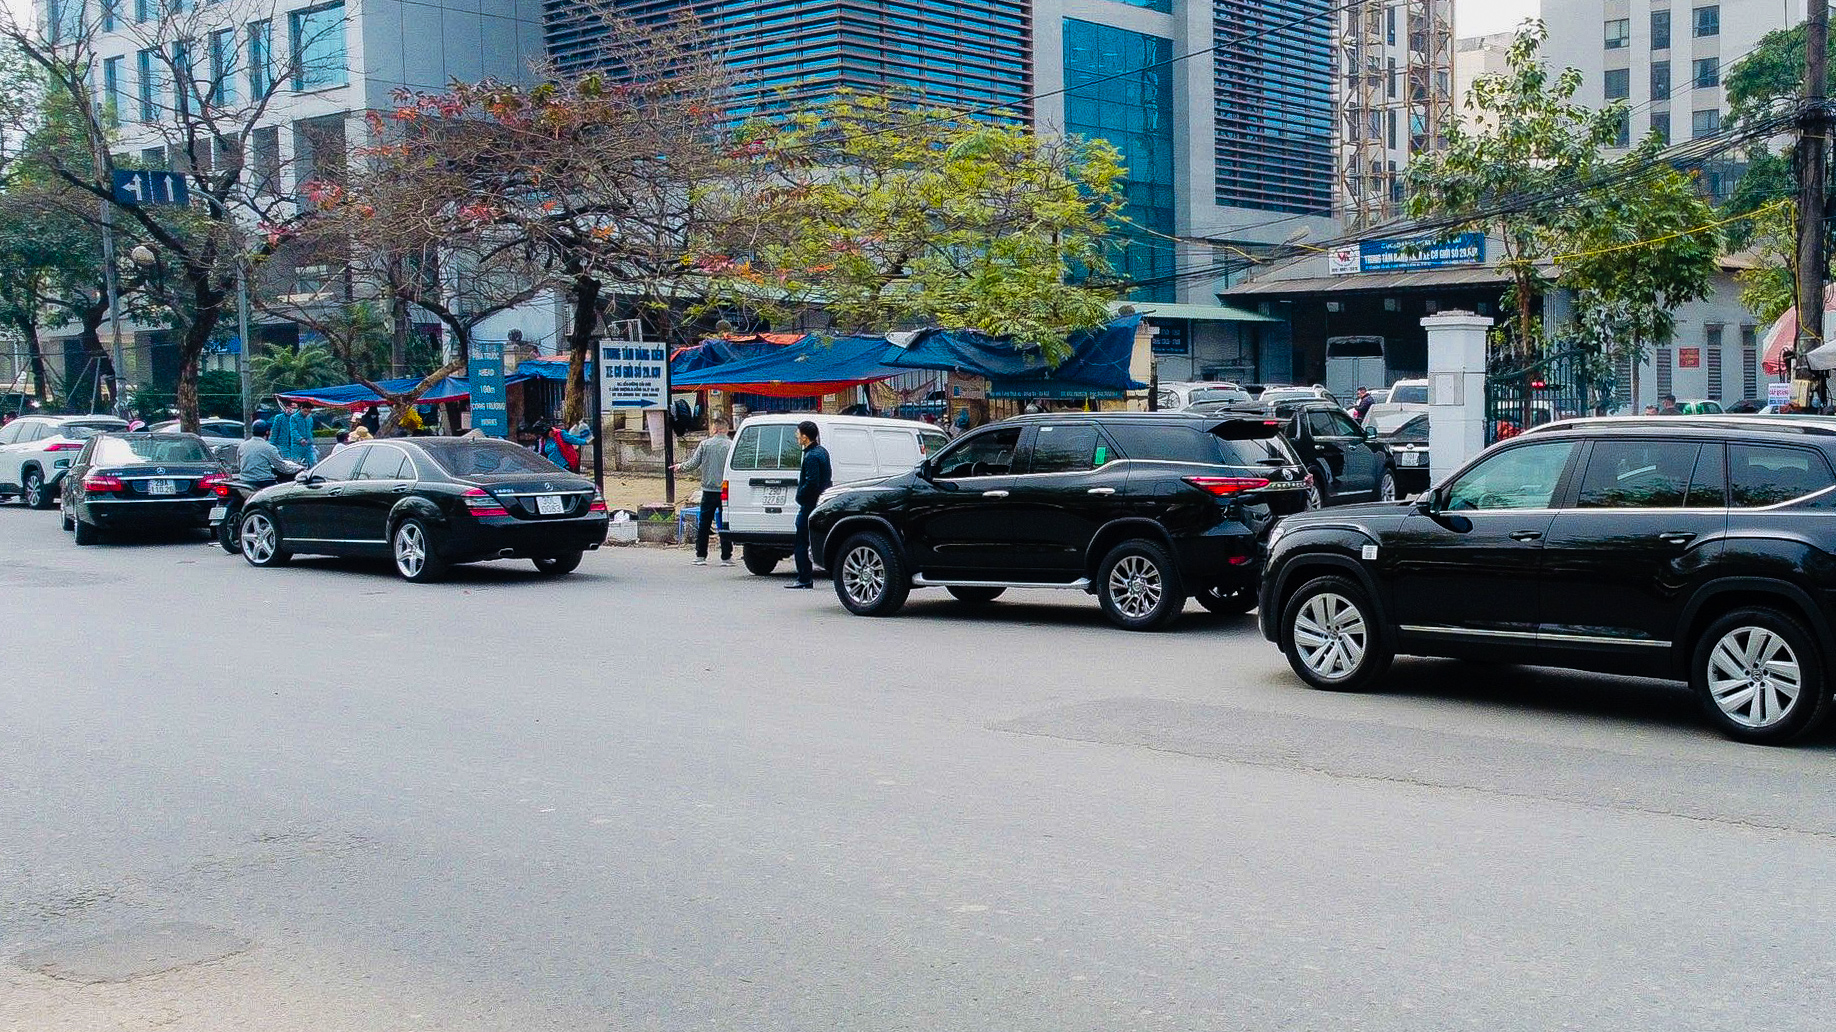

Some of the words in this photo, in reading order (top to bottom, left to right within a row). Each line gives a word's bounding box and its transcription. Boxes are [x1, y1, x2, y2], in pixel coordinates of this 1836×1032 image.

[1364, 254, 1382, 264] TRUNG
[603, 347, 621, 360] TRUNG
[605, 366, 613, 378] XE
